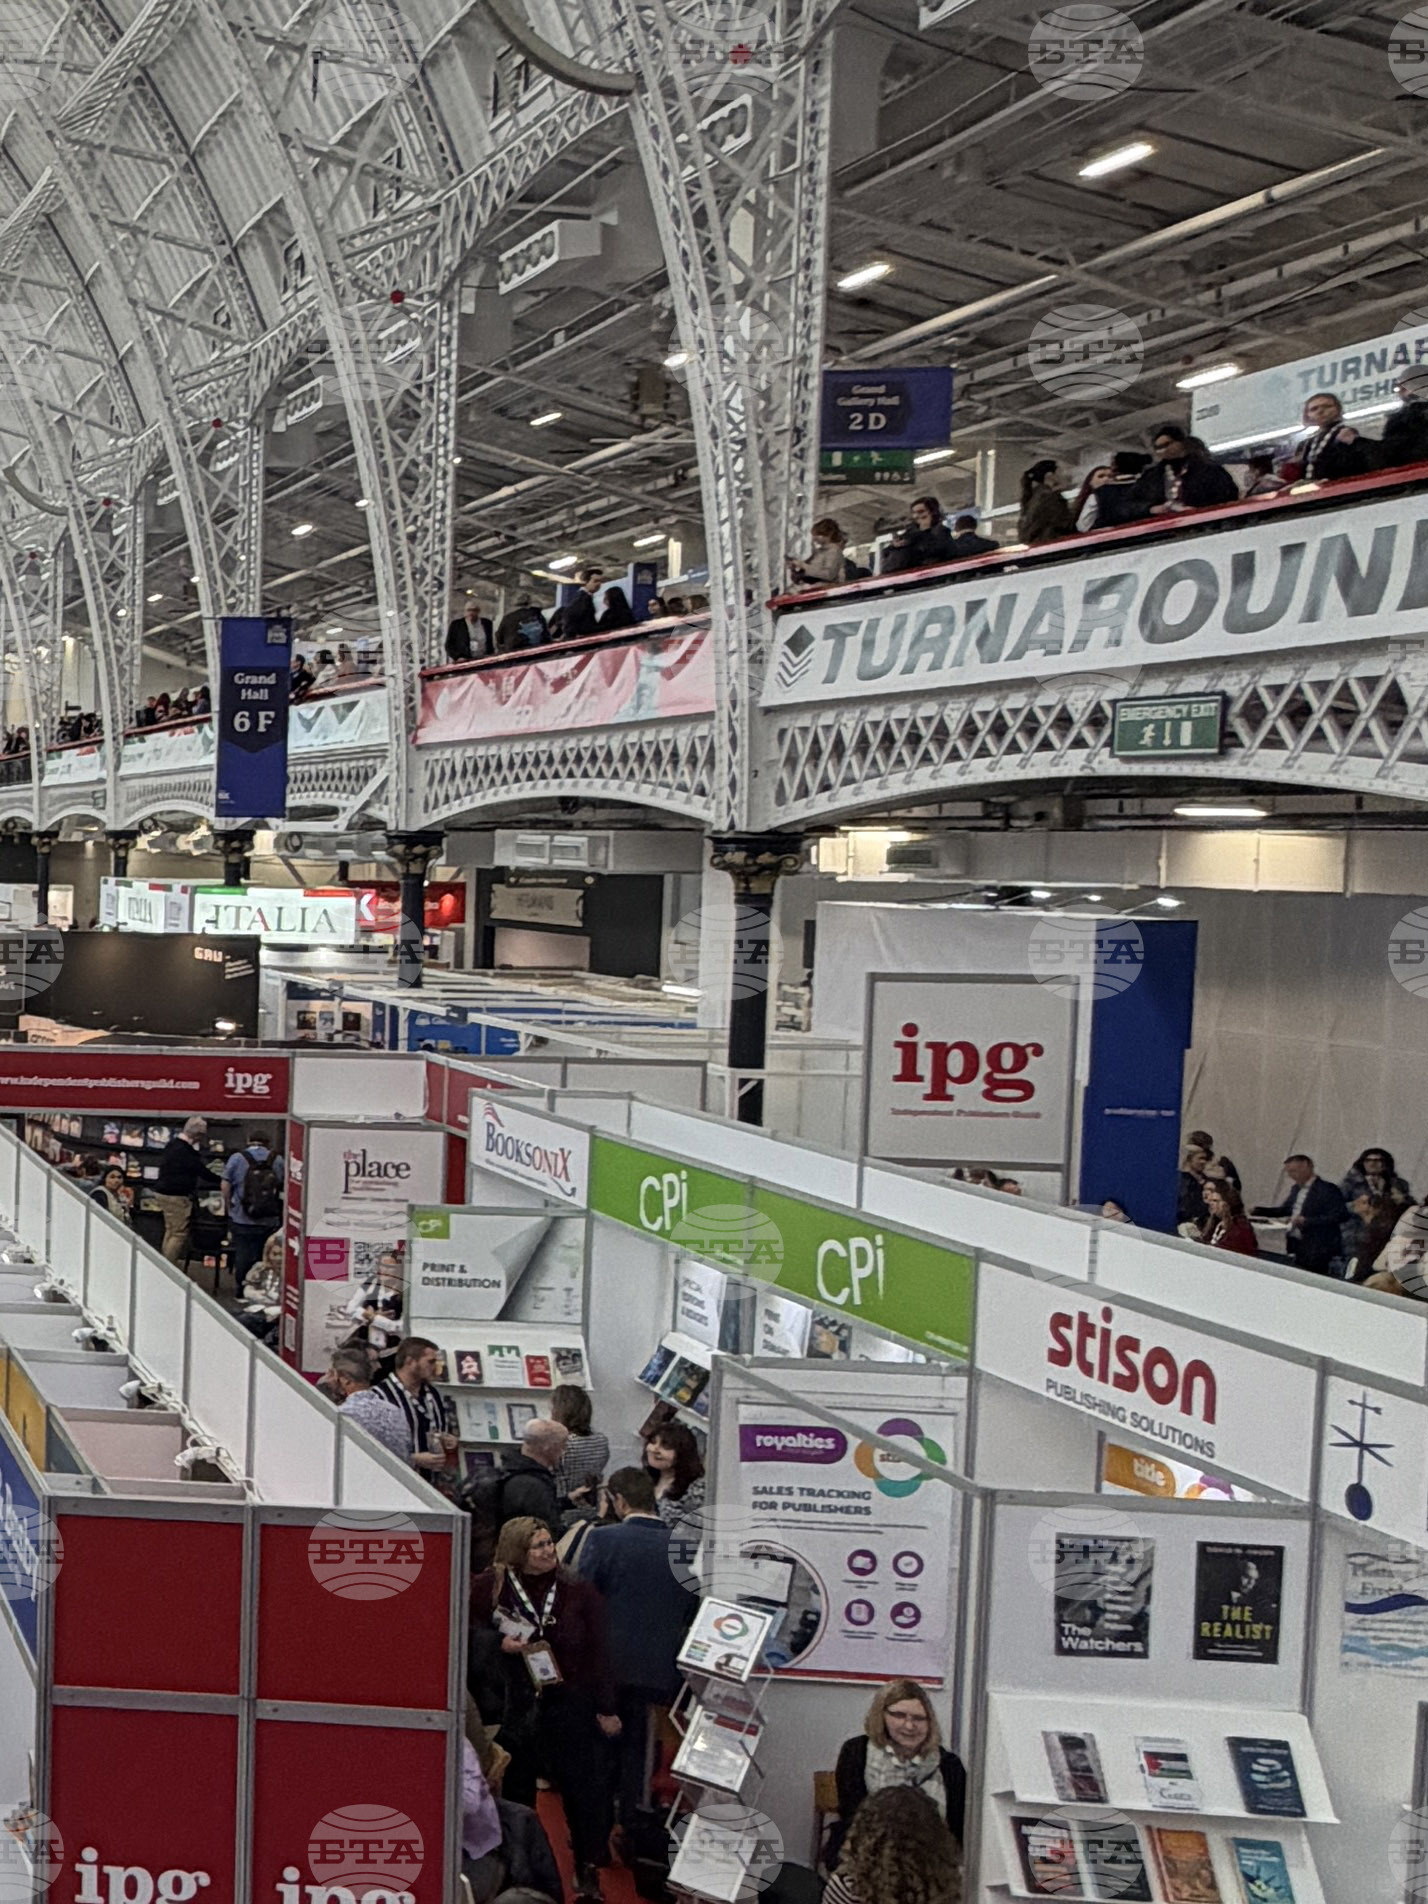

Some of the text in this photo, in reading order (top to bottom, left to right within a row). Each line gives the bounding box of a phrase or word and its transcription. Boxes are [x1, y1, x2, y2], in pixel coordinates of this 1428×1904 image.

[234, 673, 276, 685] Grand
[233, 711, 275, 733] 6 F
[892, 1022, 1044, 1104] ipg
[224, 1065, 273, 1096] ipg
[344, 1149, 412, 1195] place
[816, 1234, 885, 1306] CPi
[1048, 1306, 1217, 1425] stison
[1045, 1377, 1216, 1460] PUBLISHING SOLUTIONS
[755, 1432, 835, 1451] royalties
[798, 1486, 872, 1501] TRACKING
[751, 1500, 872, 1516] FOR PUBLISHERS
[1221, 1605, 1252, 1621] THE
[1060, 1623, 1092, 1637] The
[1200, 1622, 1273, 1641] REALIST
[1061, 1636, 1144, 1653] Watchers
